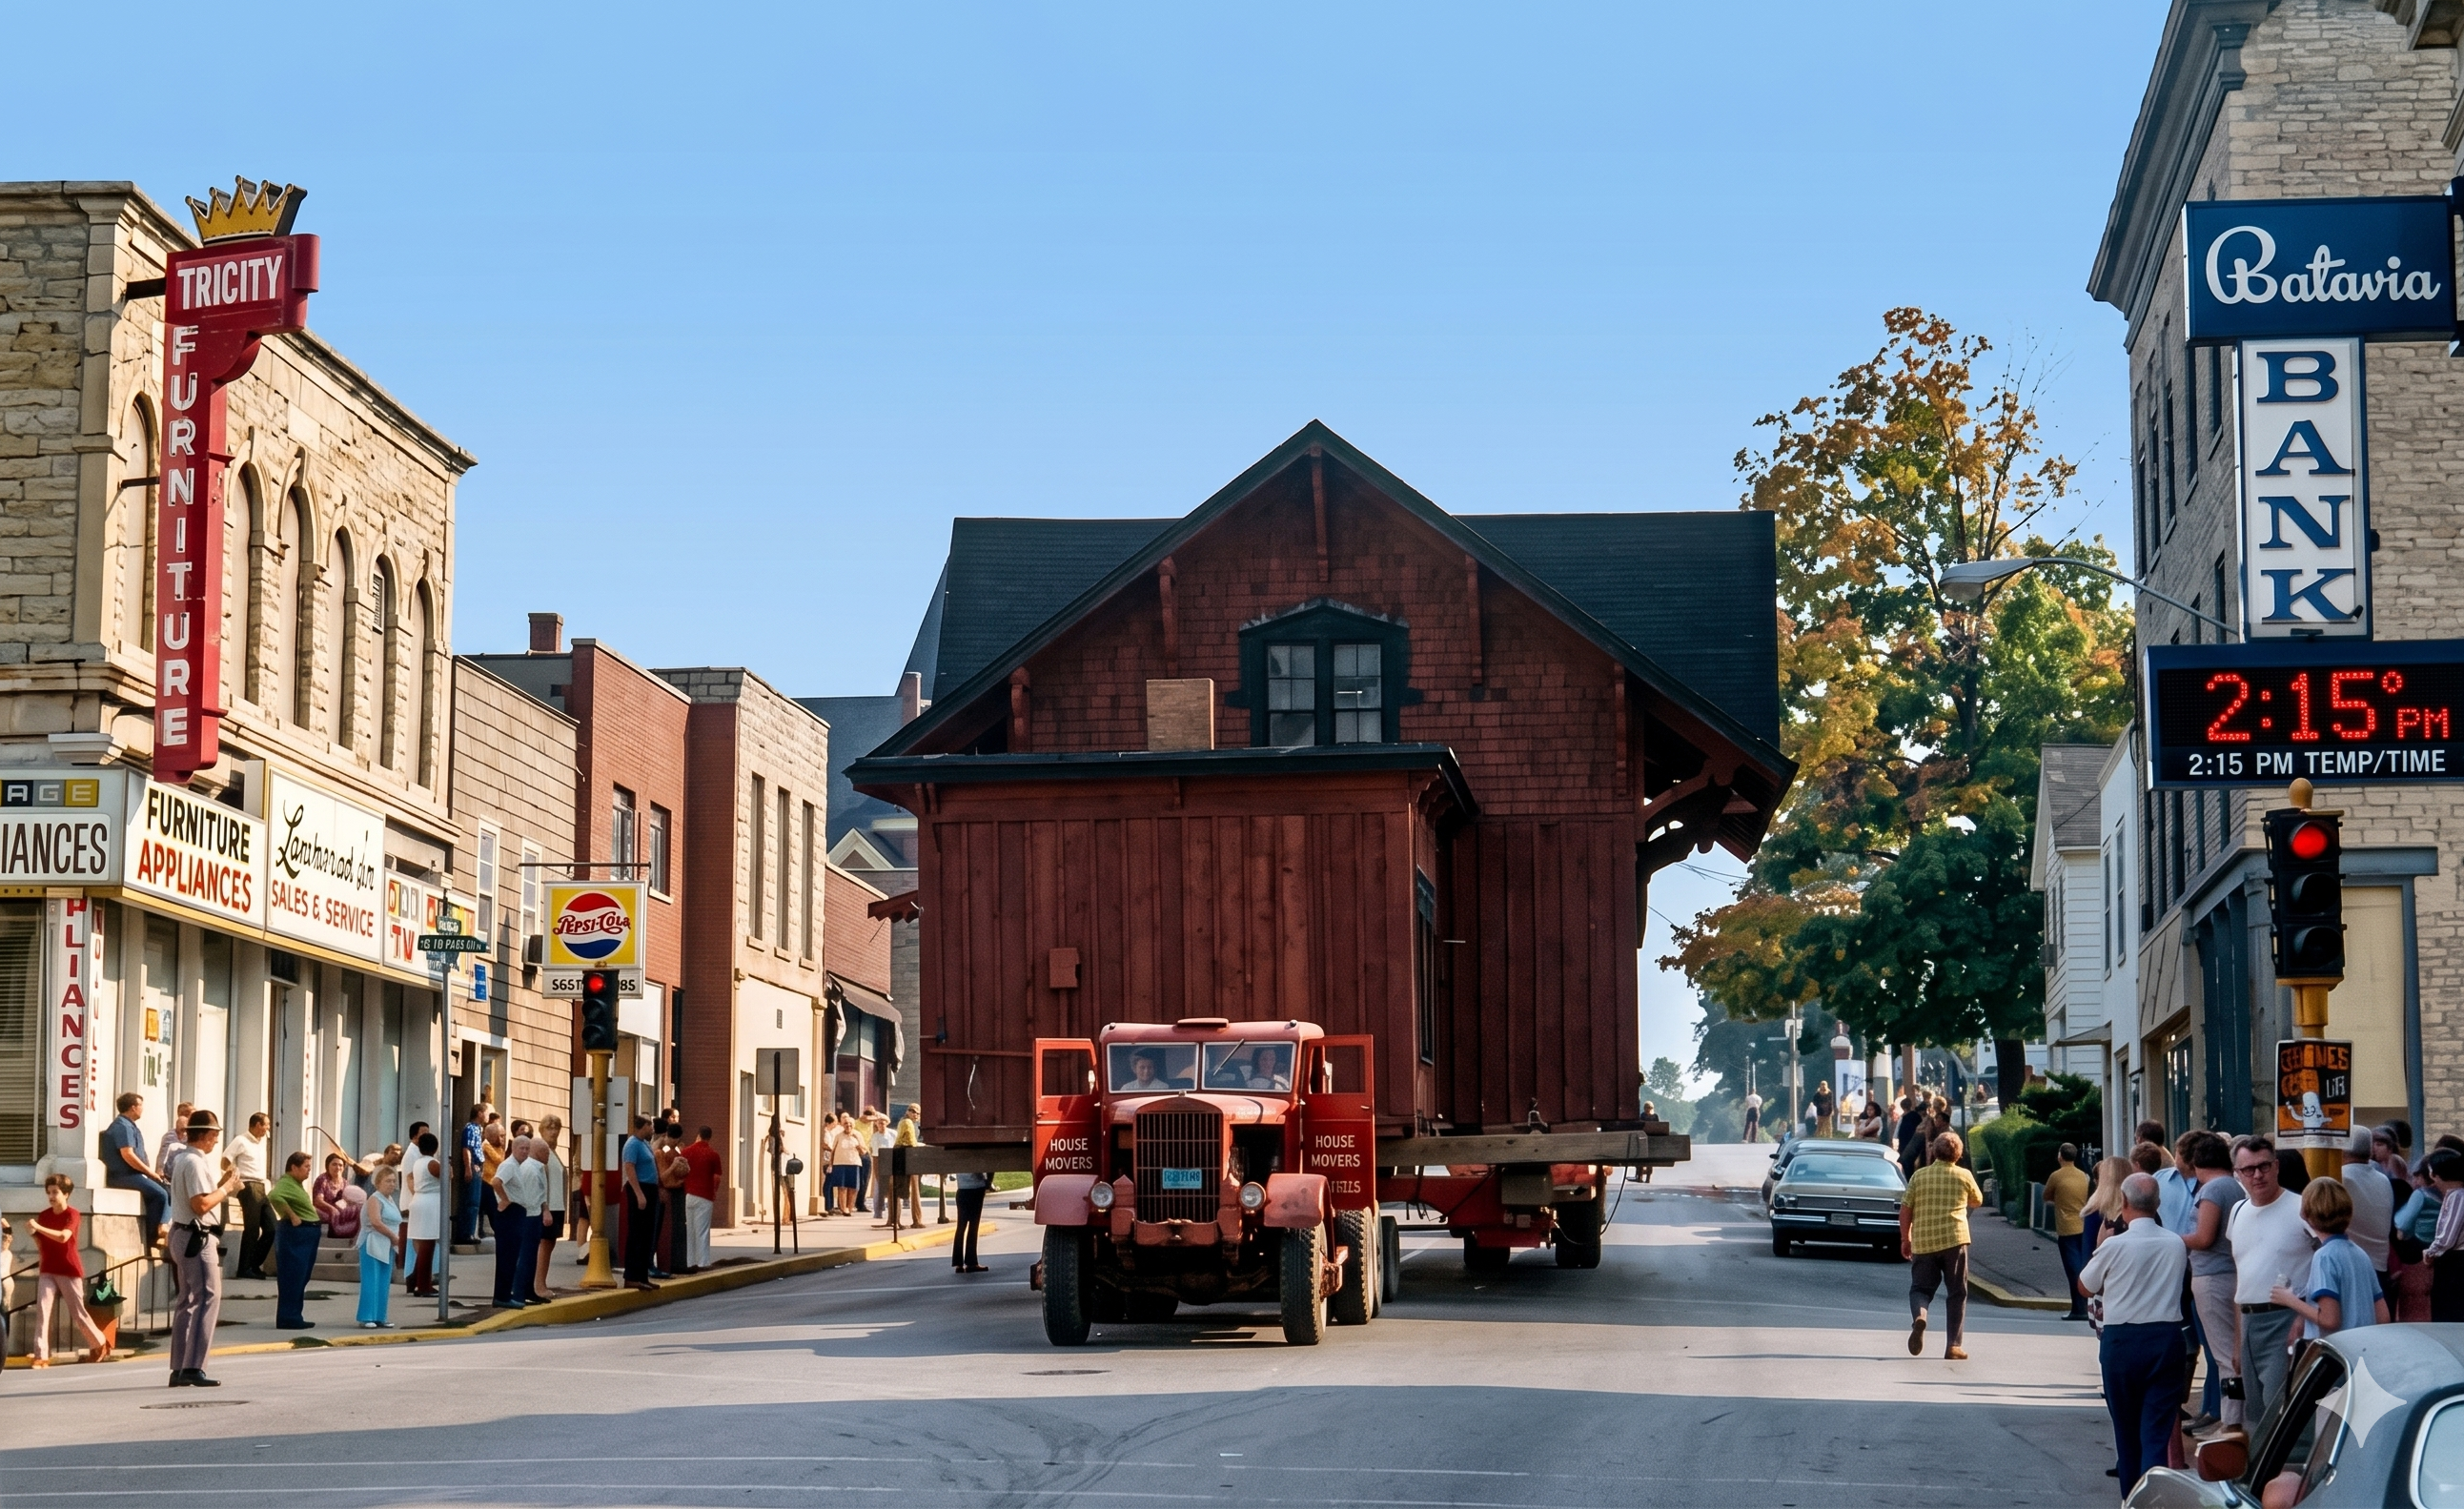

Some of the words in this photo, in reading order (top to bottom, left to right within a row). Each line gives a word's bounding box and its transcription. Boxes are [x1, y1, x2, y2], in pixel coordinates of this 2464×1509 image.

[176, 255, 283, 312] TRICITY
[2205, 225, 2442, 305] Batavia
[2255, 351, 2358, 623] BANK
[161, 324, 199, 747] FURNITURE
[2397, 707, 2450, 739] PM
[2189, 752, 2243, 776] 2:15
[2256, 752, 2293, 775] PM
[2304, 749, 2447, 775] TEMP/TIME
[147, 787, 251, 864] FURNITURE
[137, 838, 252, 914] APPLIANCES
[272, 879, 308, 918] SALES
[313, 894, 320, 922] &
[325, 897, 374, 938] SERVICE
[392, 924, 415, 964] TV
[619, 979, 636, 991] 85
[1049, 1137, 1089, 1152] HOUSE
[1311, 1153, 1361, 1168] MOVERS
[1315, 1134, 1355, 1148] HOUSE
[1045, 1155, 1093, 1170] MOVERS
